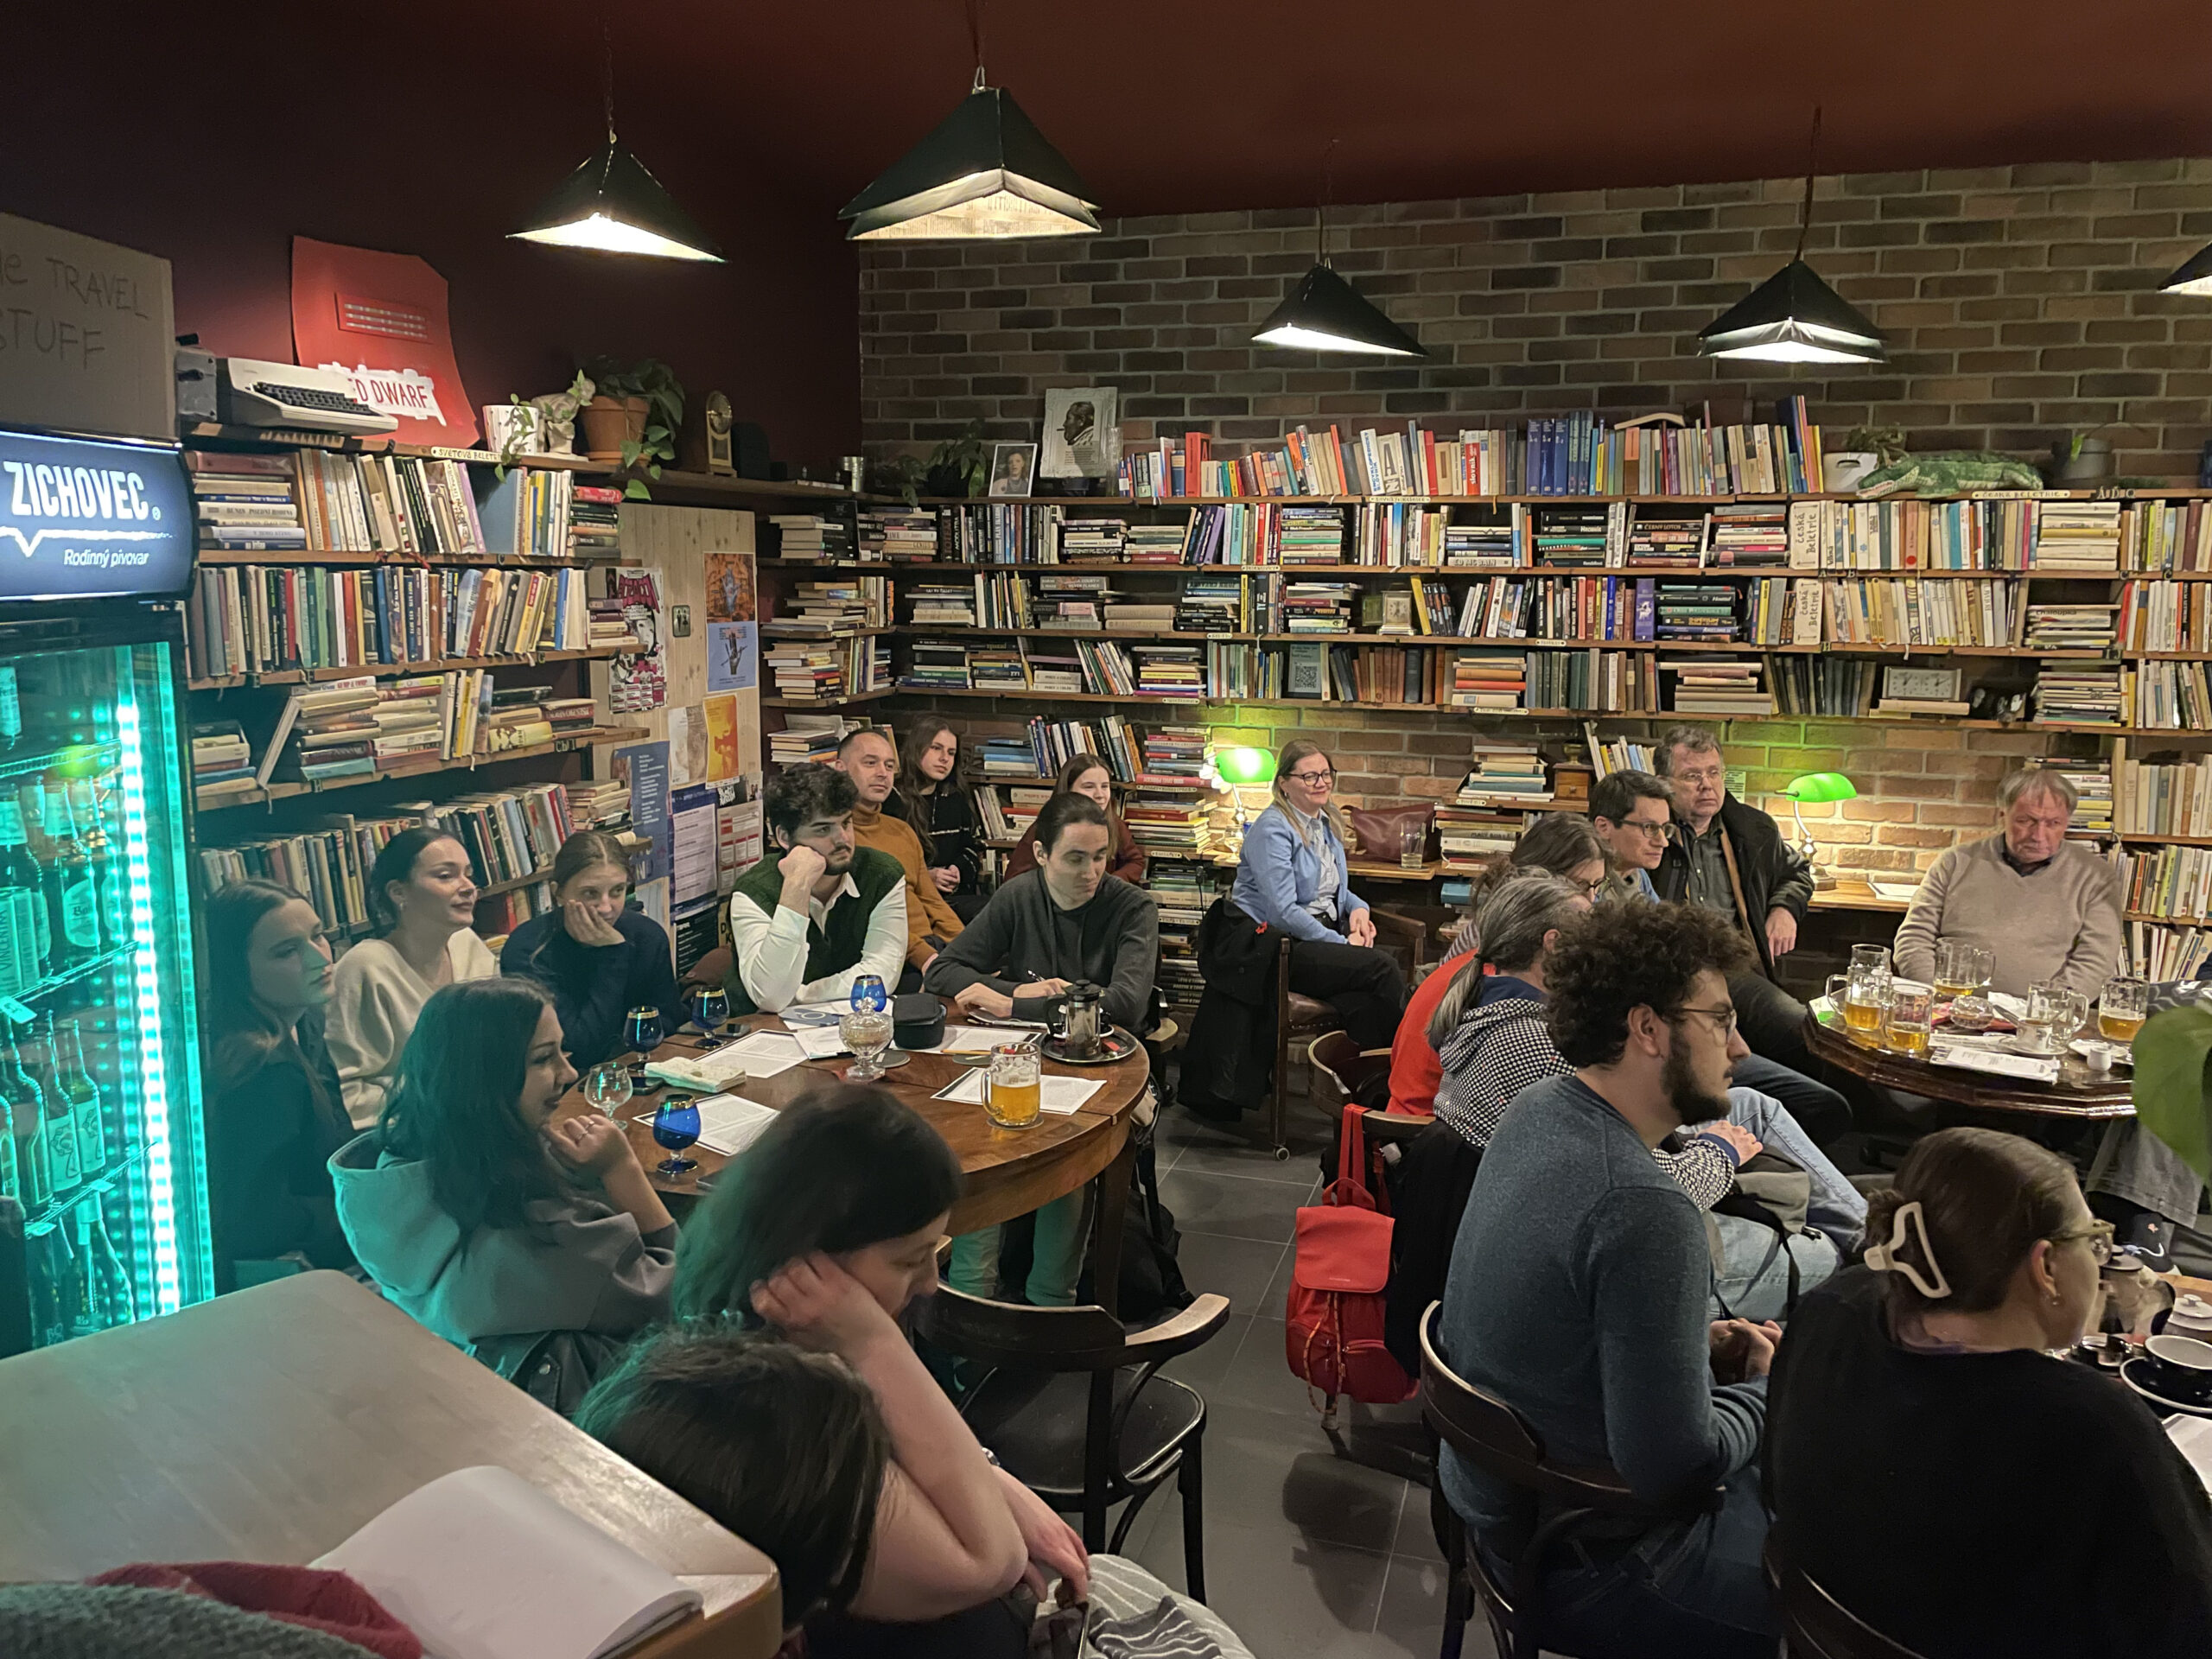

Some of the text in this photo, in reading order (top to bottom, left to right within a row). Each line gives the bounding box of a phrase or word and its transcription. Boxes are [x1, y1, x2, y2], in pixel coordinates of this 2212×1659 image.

[46, 257, 149, 320] TRAVEL
[370, 379, 428, 409] DWARF
[3, 461, 149, 520] ZICHOVEC
[64, 549, 149, 568] Rodinný pivovar
